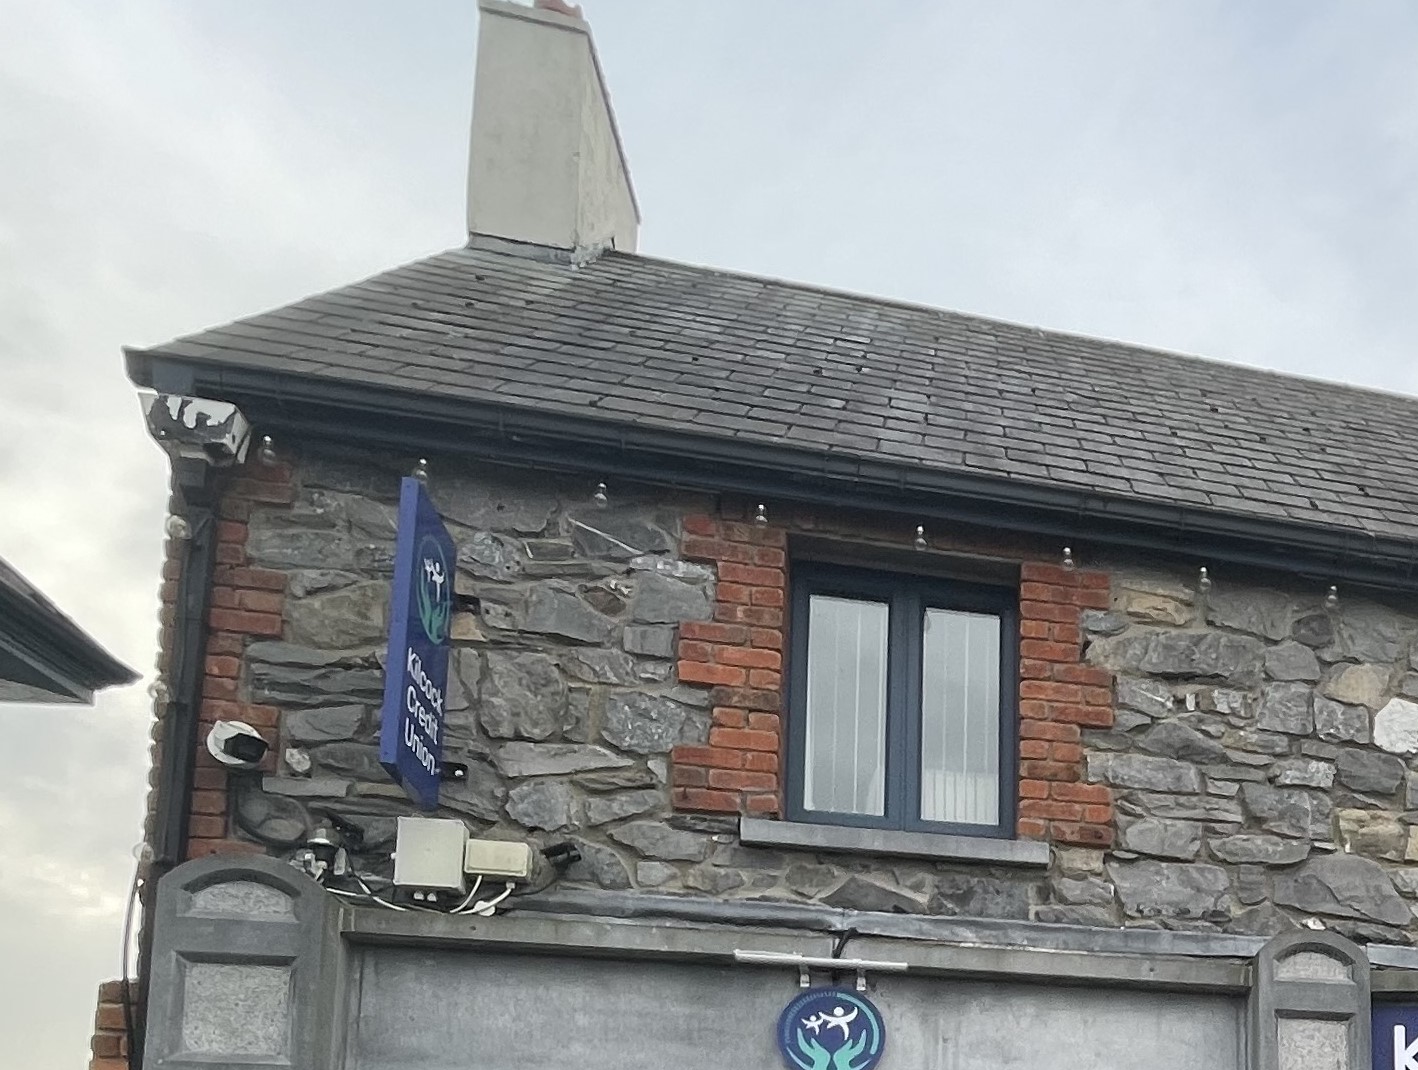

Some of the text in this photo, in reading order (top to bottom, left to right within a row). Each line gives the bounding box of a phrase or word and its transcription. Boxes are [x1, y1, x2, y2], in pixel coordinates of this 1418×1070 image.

[407, 647, 443, 717] Kilcock
[407, 685, 439, 745] Credit
[404, 717, 436, 776] Union
